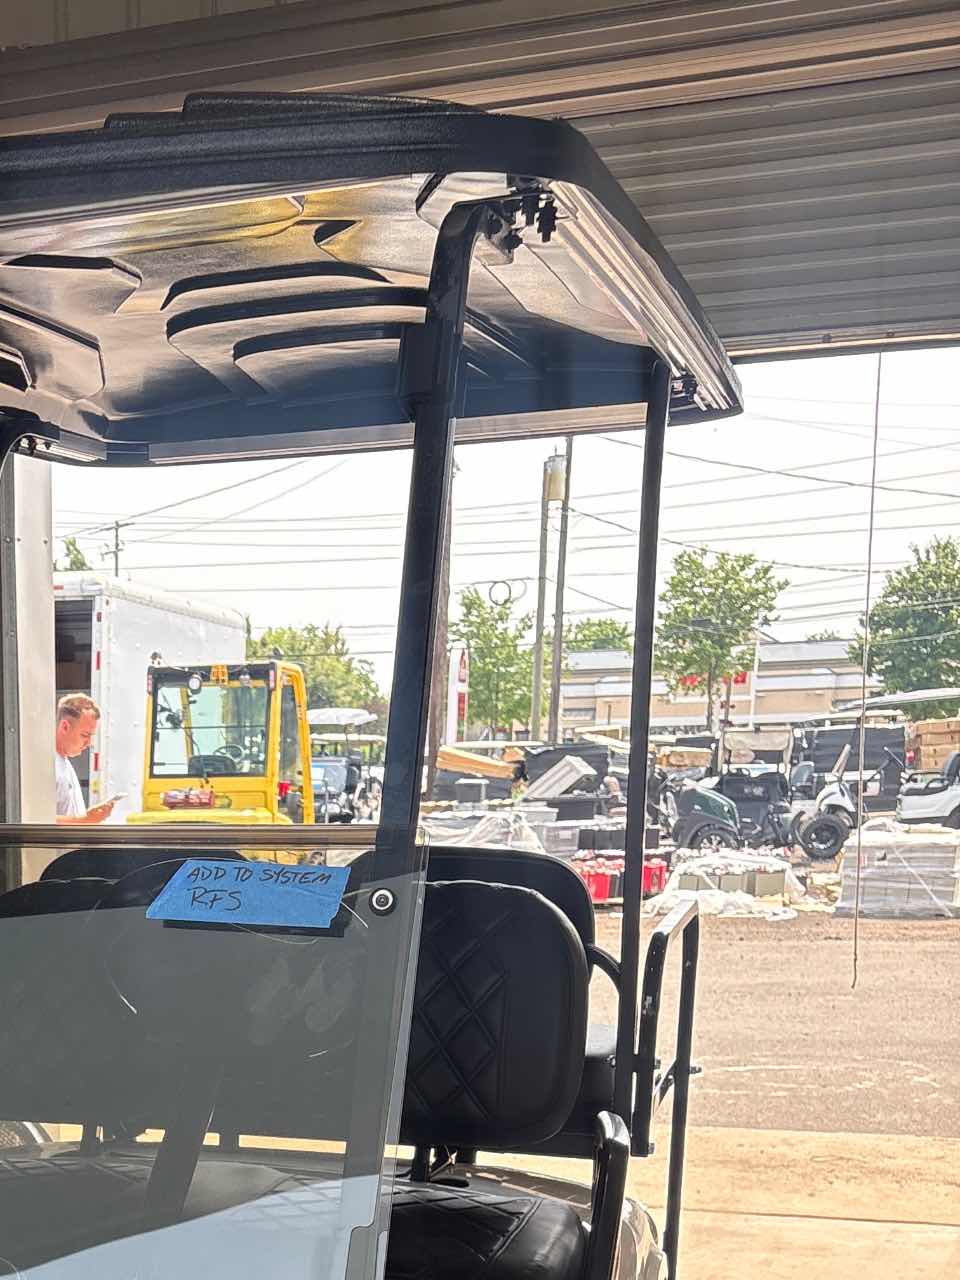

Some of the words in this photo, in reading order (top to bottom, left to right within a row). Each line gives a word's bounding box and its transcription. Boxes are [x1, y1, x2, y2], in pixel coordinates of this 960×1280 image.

[187, 866, 227, 882] ADD
[233, 867, 254, 881] TO
[259, 867, 332, 885] SYSTEM
[187, 886, 242, 911] RFS
